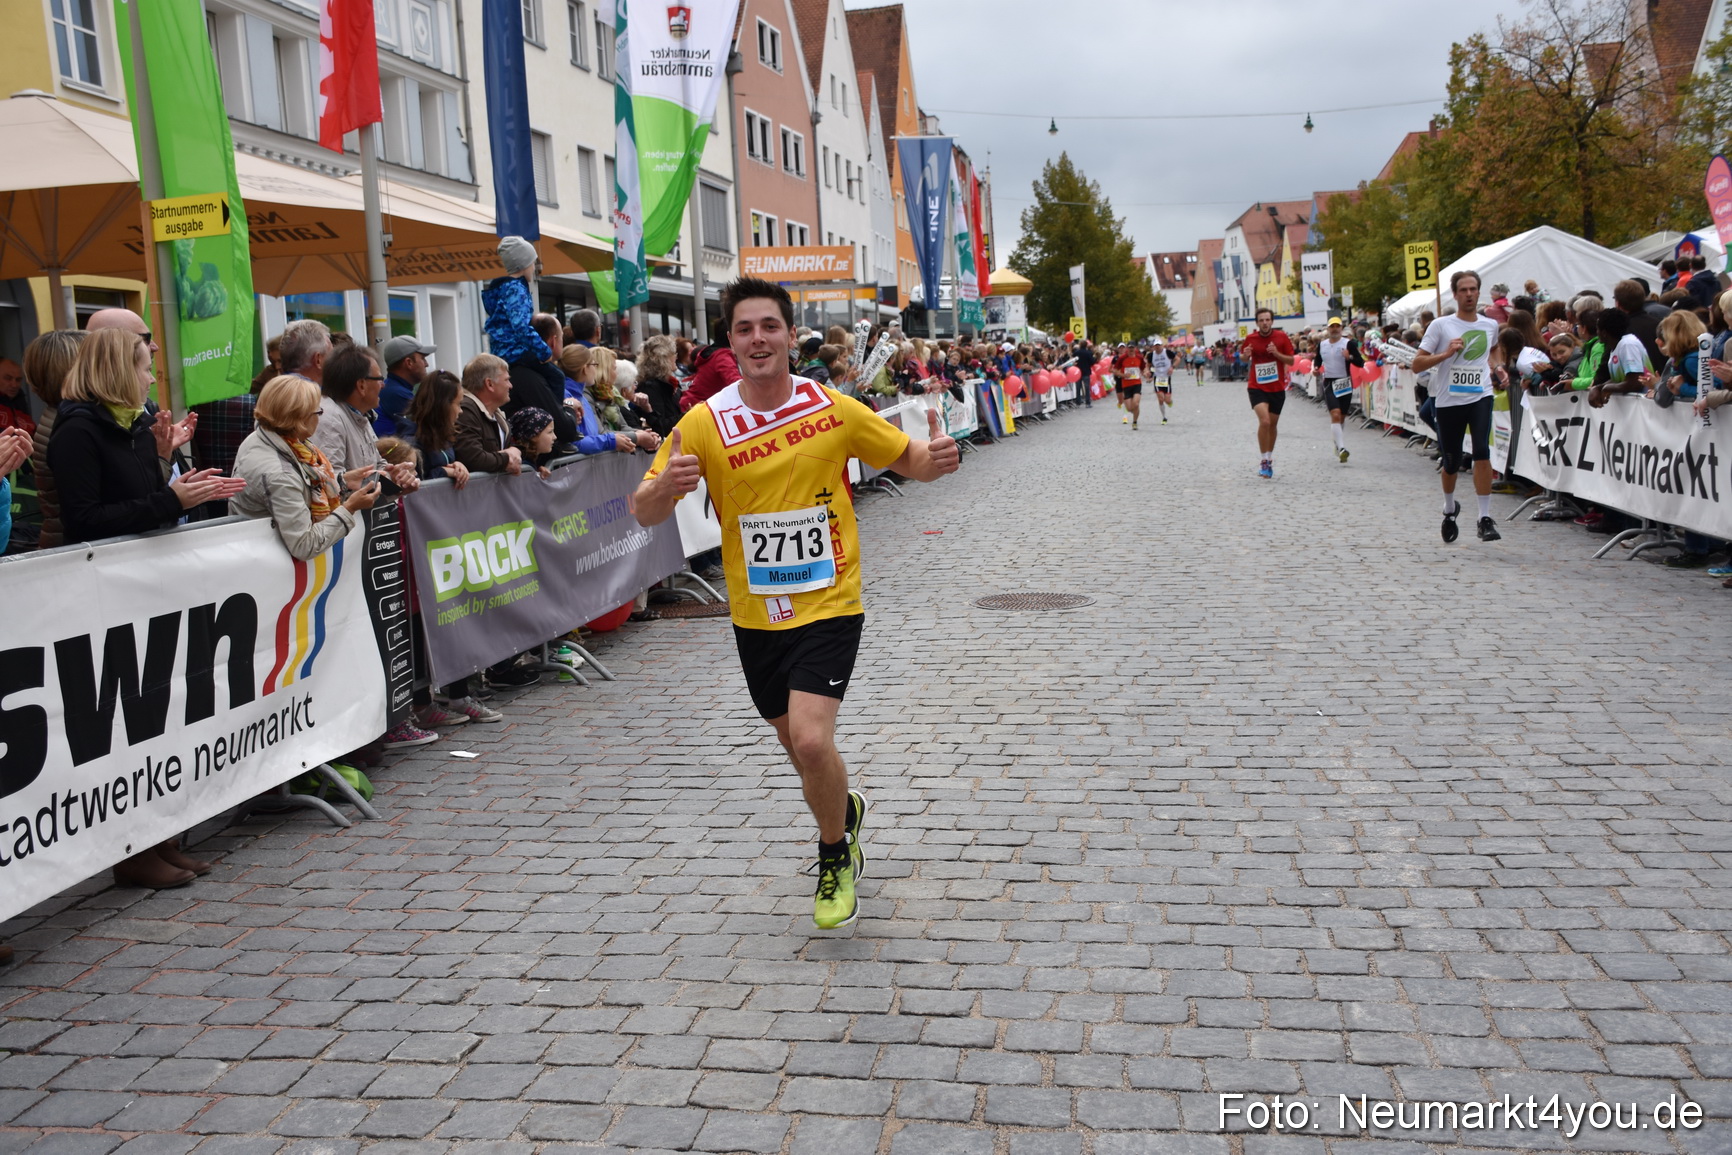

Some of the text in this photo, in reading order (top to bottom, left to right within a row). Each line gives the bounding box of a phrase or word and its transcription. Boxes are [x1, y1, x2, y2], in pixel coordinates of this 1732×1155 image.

[165, 219, 204, 236] ausgabe
[1408, 244, 1434, 255] Block
[1413, 257, 1431, 281] B
[1073, 323, 1081, 335] C
[1257, 366, 1277, 377] 2385
[1453, 372, 1481, 385] 3008
[1700, 356, 1711, 381] BMW
[727, 414, 844, 471] MAX BÖGL
[1600, 421, 1720, 503] Neumarkt
[551, 510, 589, 544] OFFICE
[587, 496, 628, 532] INDUSTRY
[742, 516, 815, 530] PARTL Neumarkt
[375, 540, 396, 551] Erdgas
[751, 527, 824, 563] 2713
[430, 526, 534, 594] BOCK
[768, 567, 812, 583] Manuel
[437, 578, 540, 627] inspired by smart concepts
[0, 592, 258, 799] swn
[194, 691, 316, 782] neumarkt
